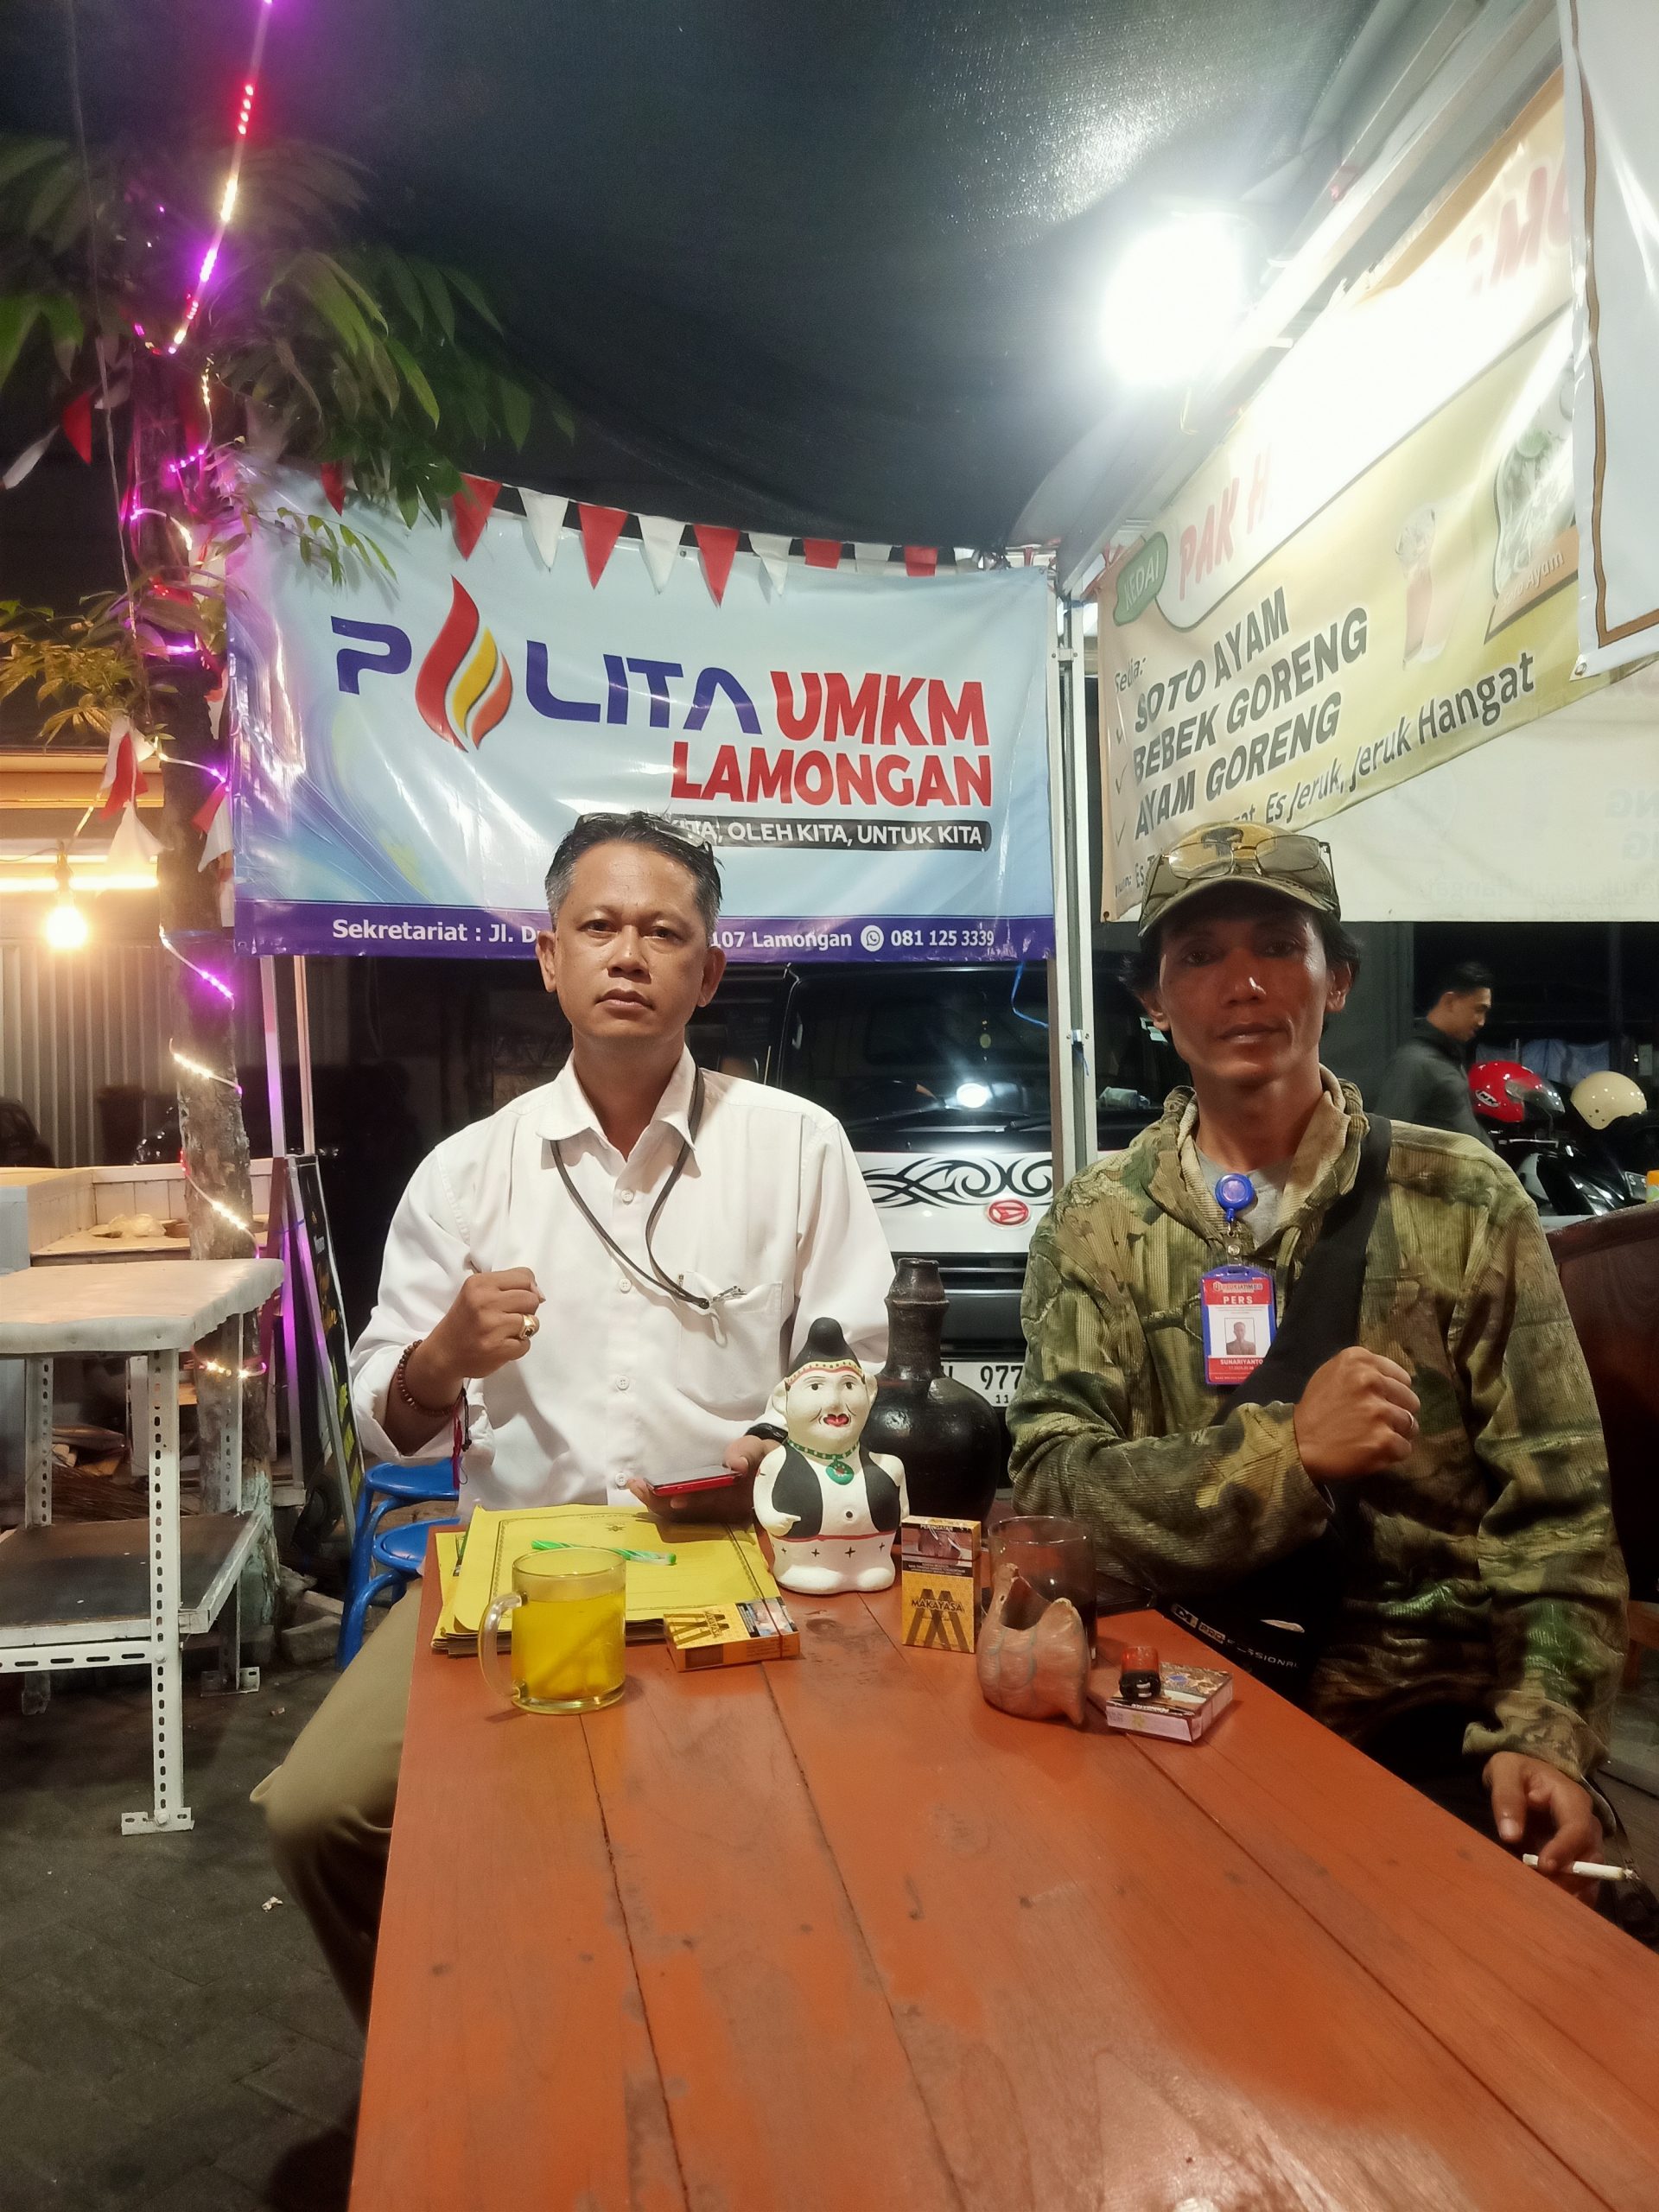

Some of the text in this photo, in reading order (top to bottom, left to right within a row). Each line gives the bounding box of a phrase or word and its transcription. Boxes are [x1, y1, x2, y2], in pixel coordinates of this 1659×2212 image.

[1179, 477, 1240, 601] PAK
[1124, 550, 1160, 612] KEDAI
[1135, 587, 1290, 734] SOTO AYAM
[770, 671, 989, 747] UMKM
[1133, 607, 1367, 786] BEBEK GORENG
[1135, 691, 1341, 841] AYAM GORENG
[1266, 791, 1287, 823] Es
[1286, 757, 1344, 823] Jeruk,
[1349, 716, 1413, 792] Jeruk
[1418, 652, 1535, 745] Hangat
[671, 741, 992, 807] LAMONGAN
[728, 822, 793, 841] OLEH
[797, 823, 853, 847] KITA,
[857, 824, 935, 844] UNTUK
[938, 825, 982, 845] KITA
[333, 918, 467, 942] Sekretariat
[488, 924, 513, 943] Jl.
[753, 931, 852, 950] Lamongan
[891, 929, 924, 946] 081
[929, 930, 957, 946] 125
[961, 930, 995, 947] 3339
[1223, 1295, 1253, 1305] PERS
[912, 1599, 965, 1612] MAKAYASA
